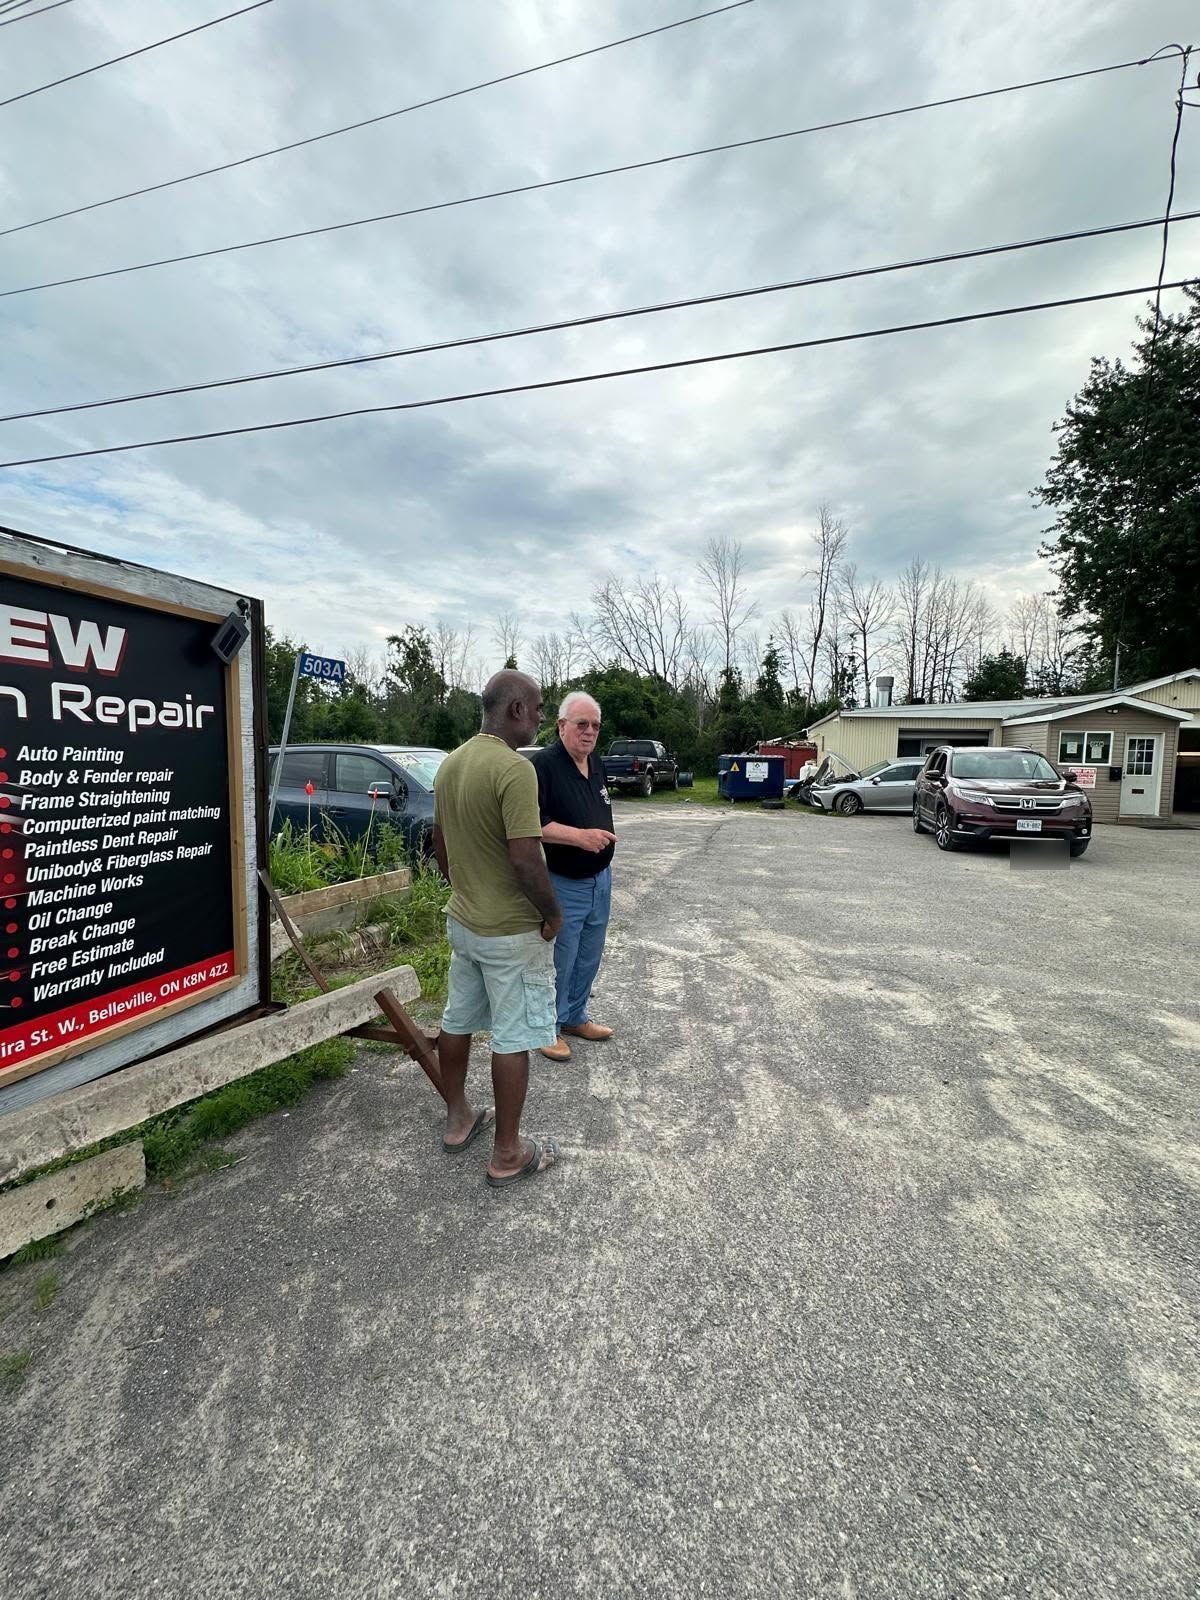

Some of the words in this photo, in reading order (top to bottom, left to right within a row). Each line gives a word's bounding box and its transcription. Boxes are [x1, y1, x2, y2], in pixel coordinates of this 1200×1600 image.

[0, 604, 127, 677] EW
[304, 657, 343, 679] 503A
[51, 682, 214, 733] Repair
[17, 746, 57, 761] Auto
[63, 747, 124, 764] Painting
[19, 770, 63, 788] Body
[67, 770, 79, 784] &
[84, 769, 133, 783] Fender
[136, 769, 174, 784] repair
[21, 794, 74, 810] Frame
[79, 789, 170, 807] Straightening
[23, 812, 131, 834] Computerized
[133, 809, 166, 827] paint
[169, 806, 220, 821] matching
[24, 839, 98, 859] Paintless
[102, 833, 135, 849] Dent
[138, 828, 178, 845] Repair
[107, 850, 173, 871] Fiberglass
[177, 843, 212, 859] Repair
[27, 883, 96, 907] Machine
[102, 874, 143, 892] Works
[29, 912, 51, 930] Oil
[56, 902, 112, 924] Change
[29, 930, 78, 954] Break
[83, 918, 135, 940] Change
[31, 958, 67, 979] Free
[72, 939, 134, 967] Estimate
[34, 969, 104, 1001] Warranty
[108, 948, 164, 978] Included
[0, 1039, 25, 1058] ira
[31, 1030, 53, 1045] St.
[58, 1018, 84, 1034] W.,
[90, 992, 158, 1023] Belleville,
[160, 980, 179, 996] ON
[184, 971, 206, 988] K8N
[209, 963, 228, 977] 4Z2
